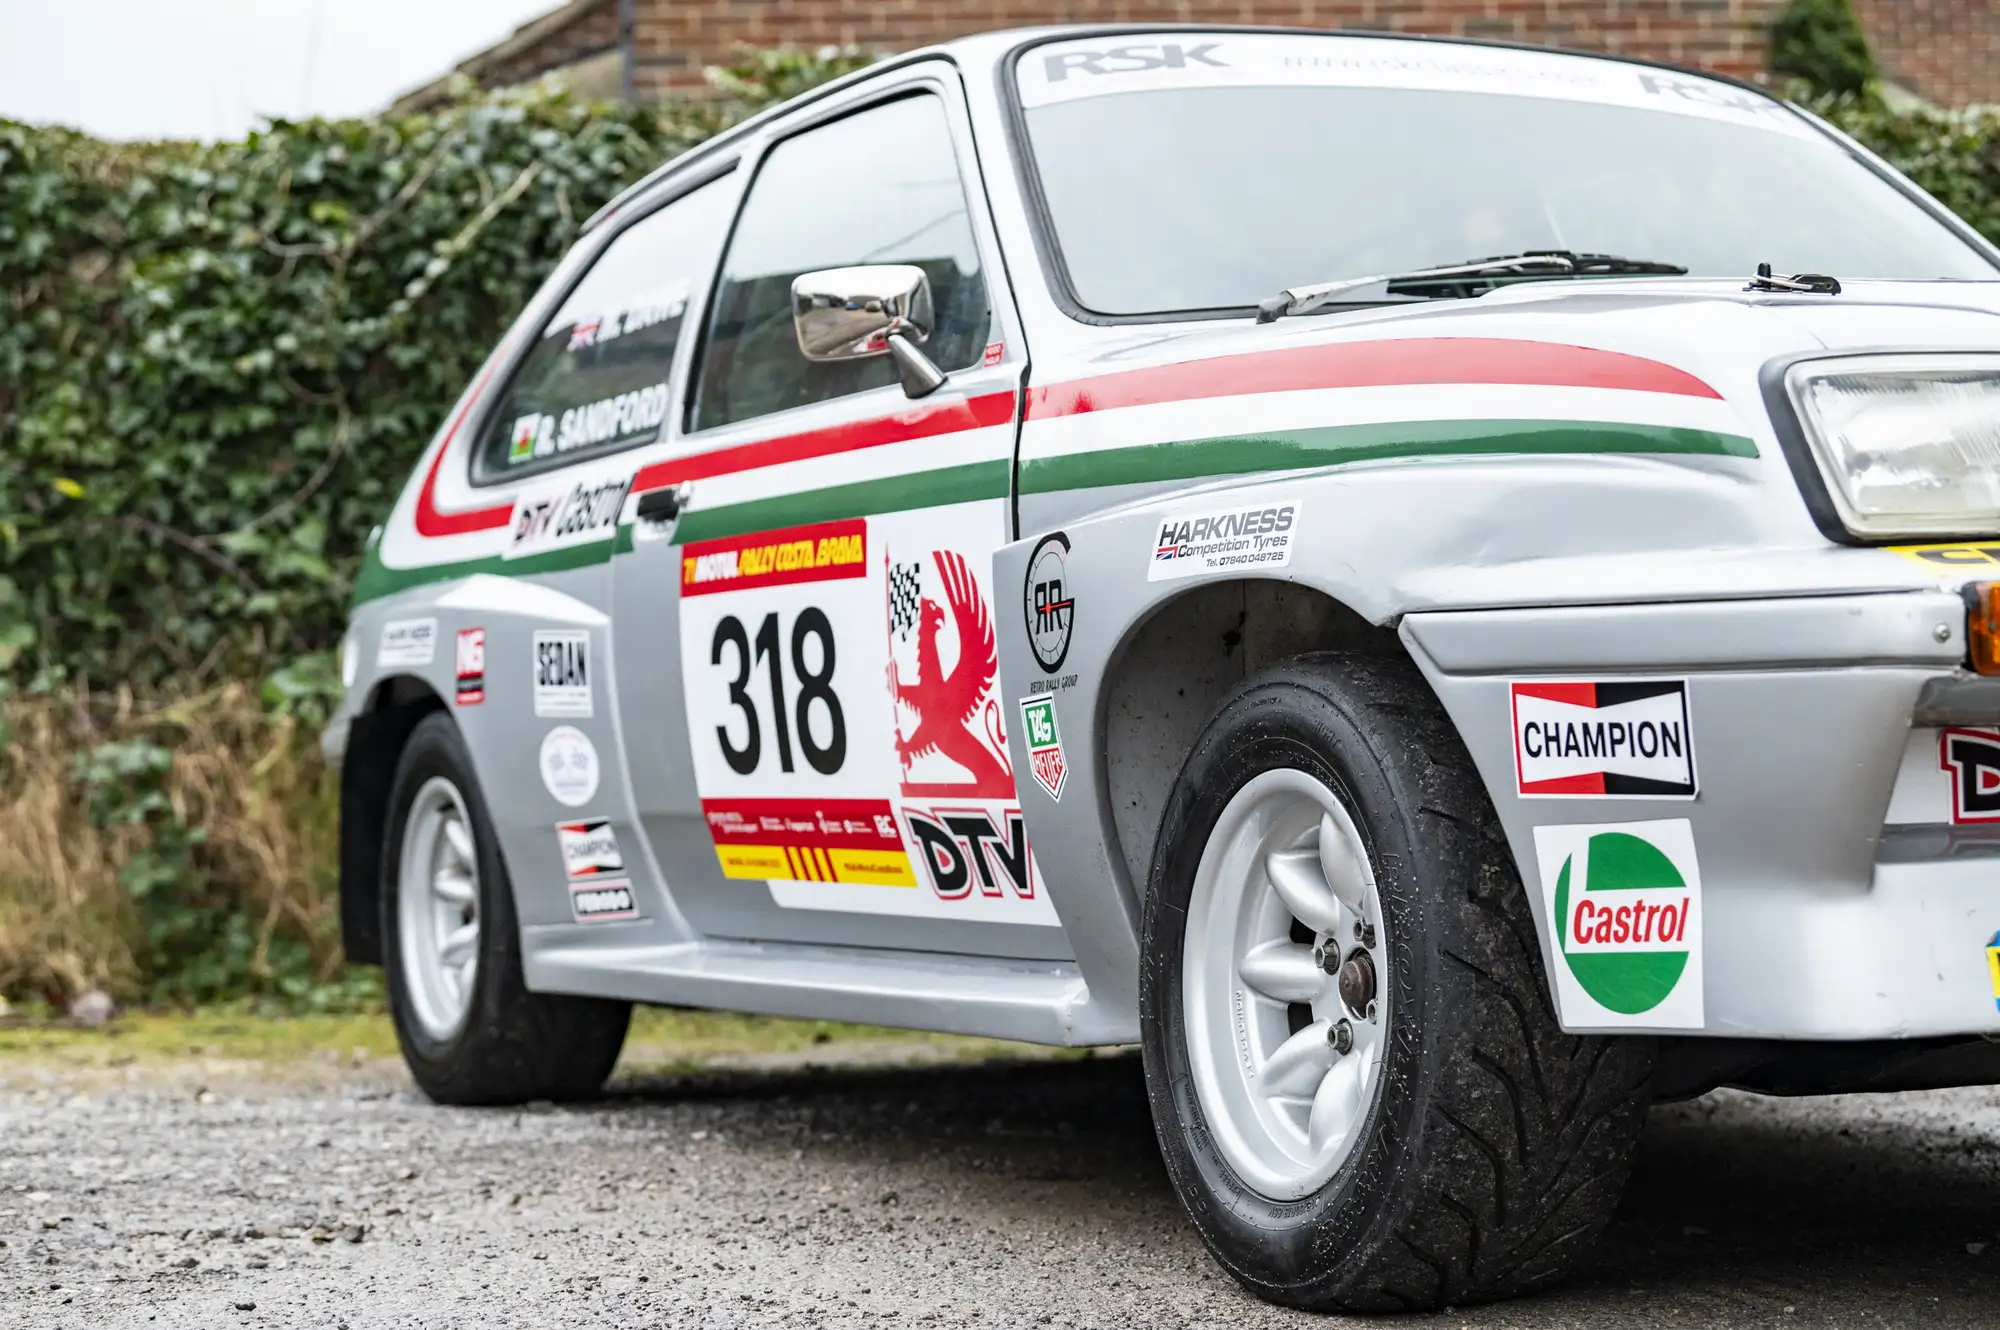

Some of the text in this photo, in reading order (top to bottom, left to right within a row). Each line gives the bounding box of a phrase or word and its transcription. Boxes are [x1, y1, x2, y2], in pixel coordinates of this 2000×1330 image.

[1043, 43, 1231, 83] RSK
[1158, 506, 1295, 547] HARKNESS
[737, 544, 778, 577] RALLY
[1177, 535, 1289, 558] Competition Tyres
[1219, 554, 1247, 566] 07840
[1249, 551, 1284, 563] 048725
[711, 606, 847, 776] 318
[1046, 677, 1061, 691] RALLY
[1061, 674, 1079, 693] GROUP
[1028, 706, 1052, 743] TAG
[1523, 720, 1683, 759] CHAMPION
[1033, 749, 1063, 785] HEUER
[905, 807, 1033, 898] DTV
[1572, 896, 1691, 945] Castrol
